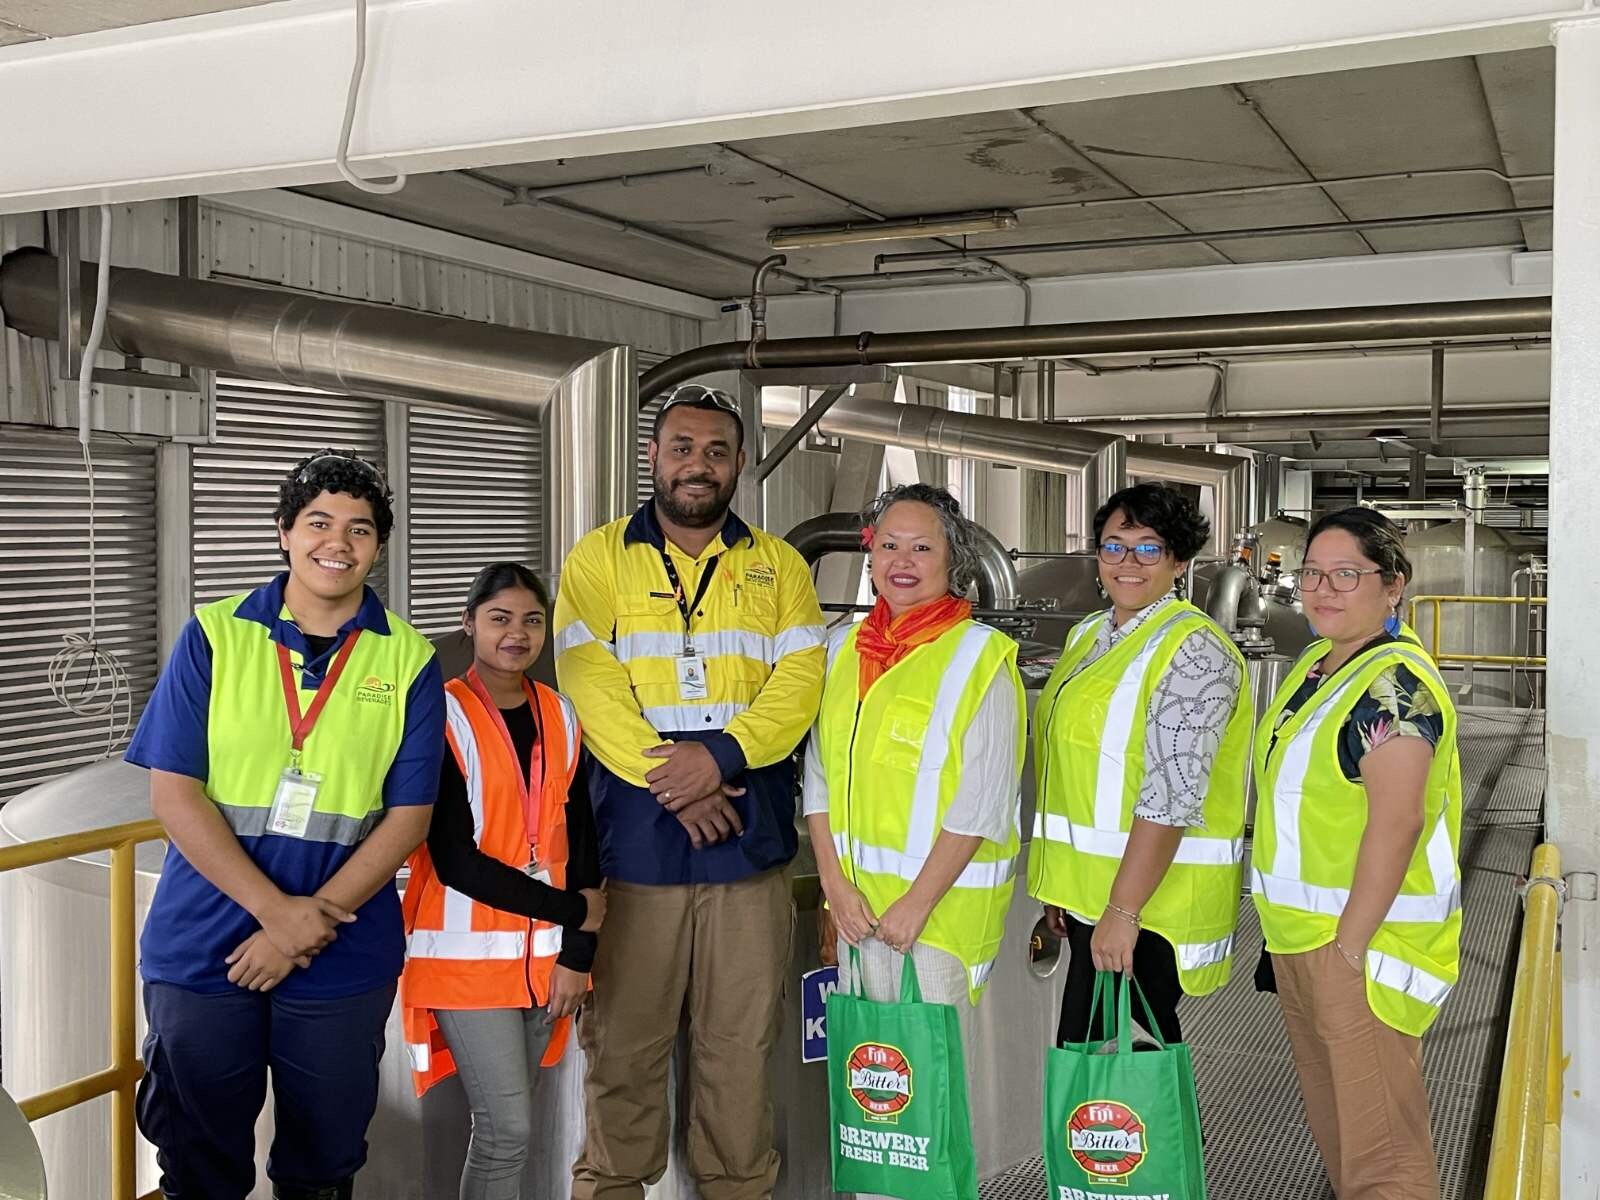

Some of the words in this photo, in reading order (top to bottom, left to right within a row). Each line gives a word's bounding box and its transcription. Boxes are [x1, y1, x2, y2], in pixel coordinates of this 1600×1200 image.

[357, 691, 391, 700] PARADISE
[860, 1070, 902, 1089] Bitter
[869, 1101, 890, 1111] BEER
[839, 1123, 930, 1155] BREWERY
[1081, 1131, 1132, 1149] Bitter
[840, 1141, 883, 1165] FRESH
[888, 1151, 929, 1171] BEER
[1094, 1163, 1120, 1172] BEER
